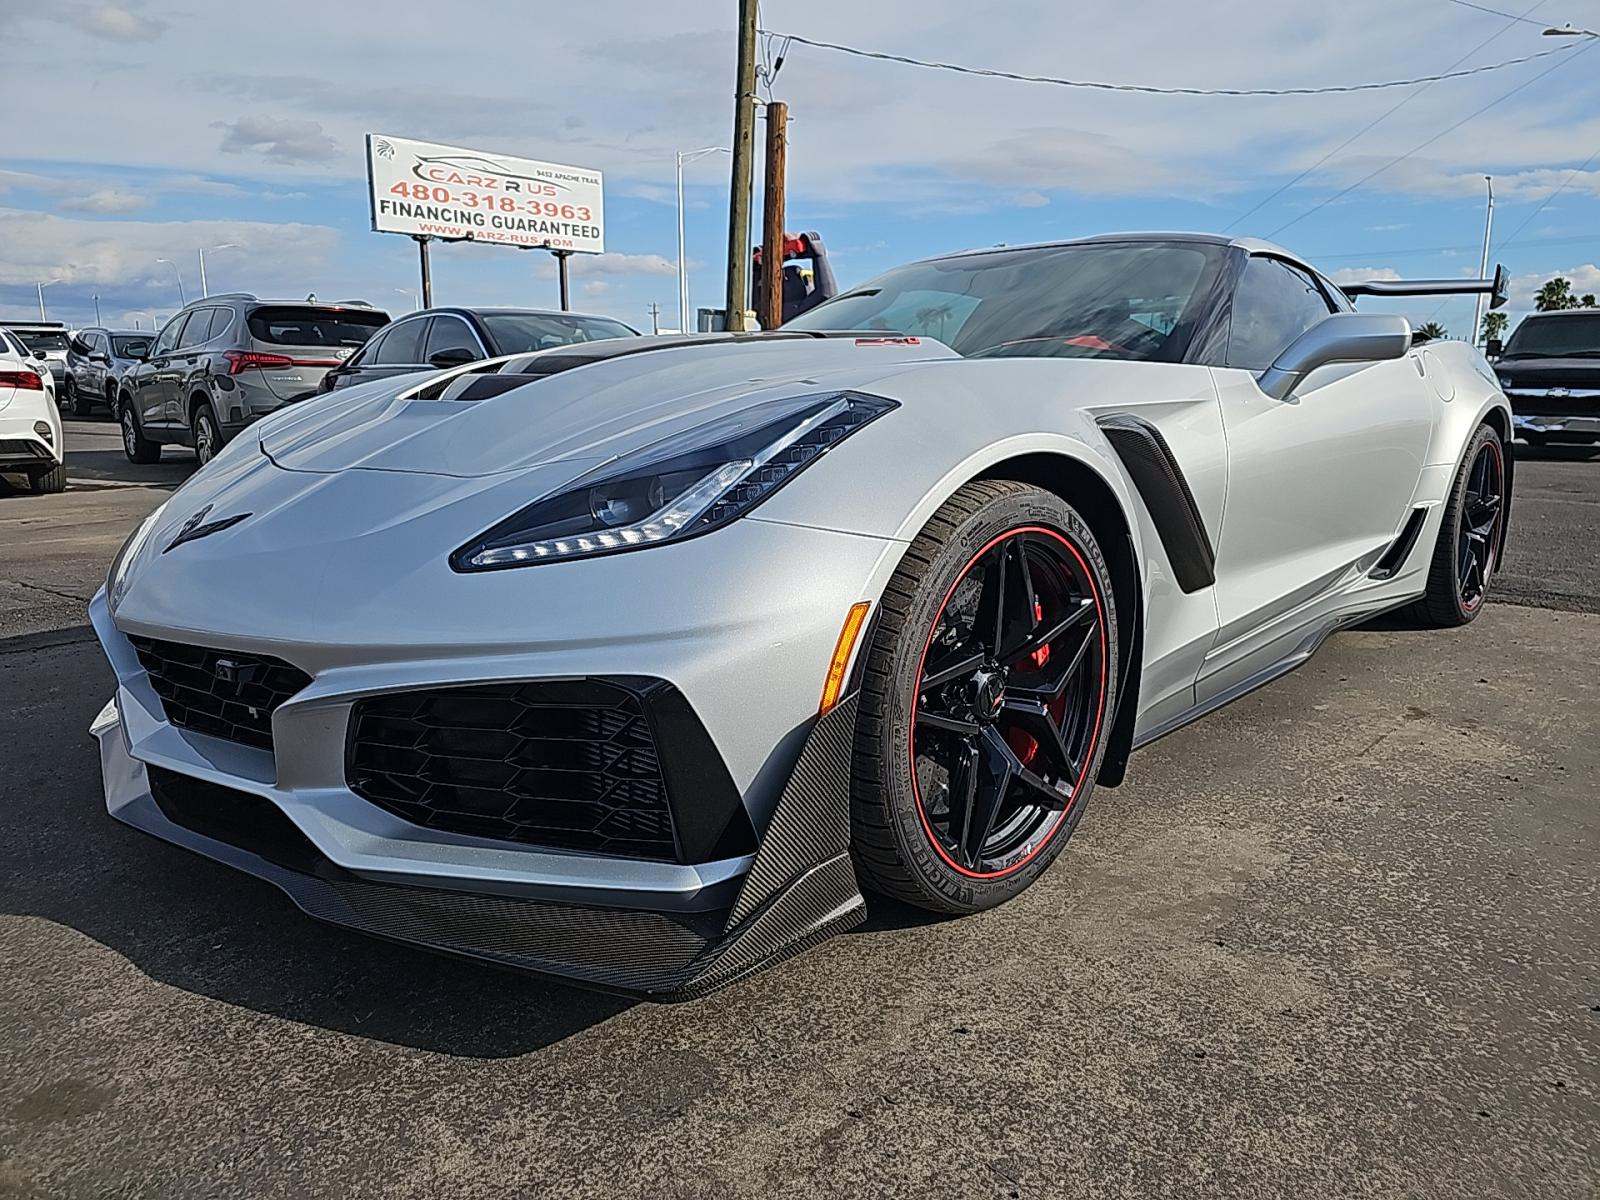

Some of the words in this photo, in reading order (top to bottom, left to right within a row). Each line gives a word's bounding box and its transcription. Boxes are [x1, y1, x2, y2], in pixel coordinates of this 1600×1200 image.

[429, 168, 498, 188] CARZ
[505, 180, 521, 193] R
[527, 182, 556, 197] US
[554, 172, 580, 182] APACHE
[581, 176, 600, 186] TRAIL
[390, 181, 592, 222] 480-318-3963
[379, 199, 485, 227] FINANCING
[491, 215, 600, 239] GUARANTEED
[418, 223, 574, 247] WWW.ARZ-RUS.OM
